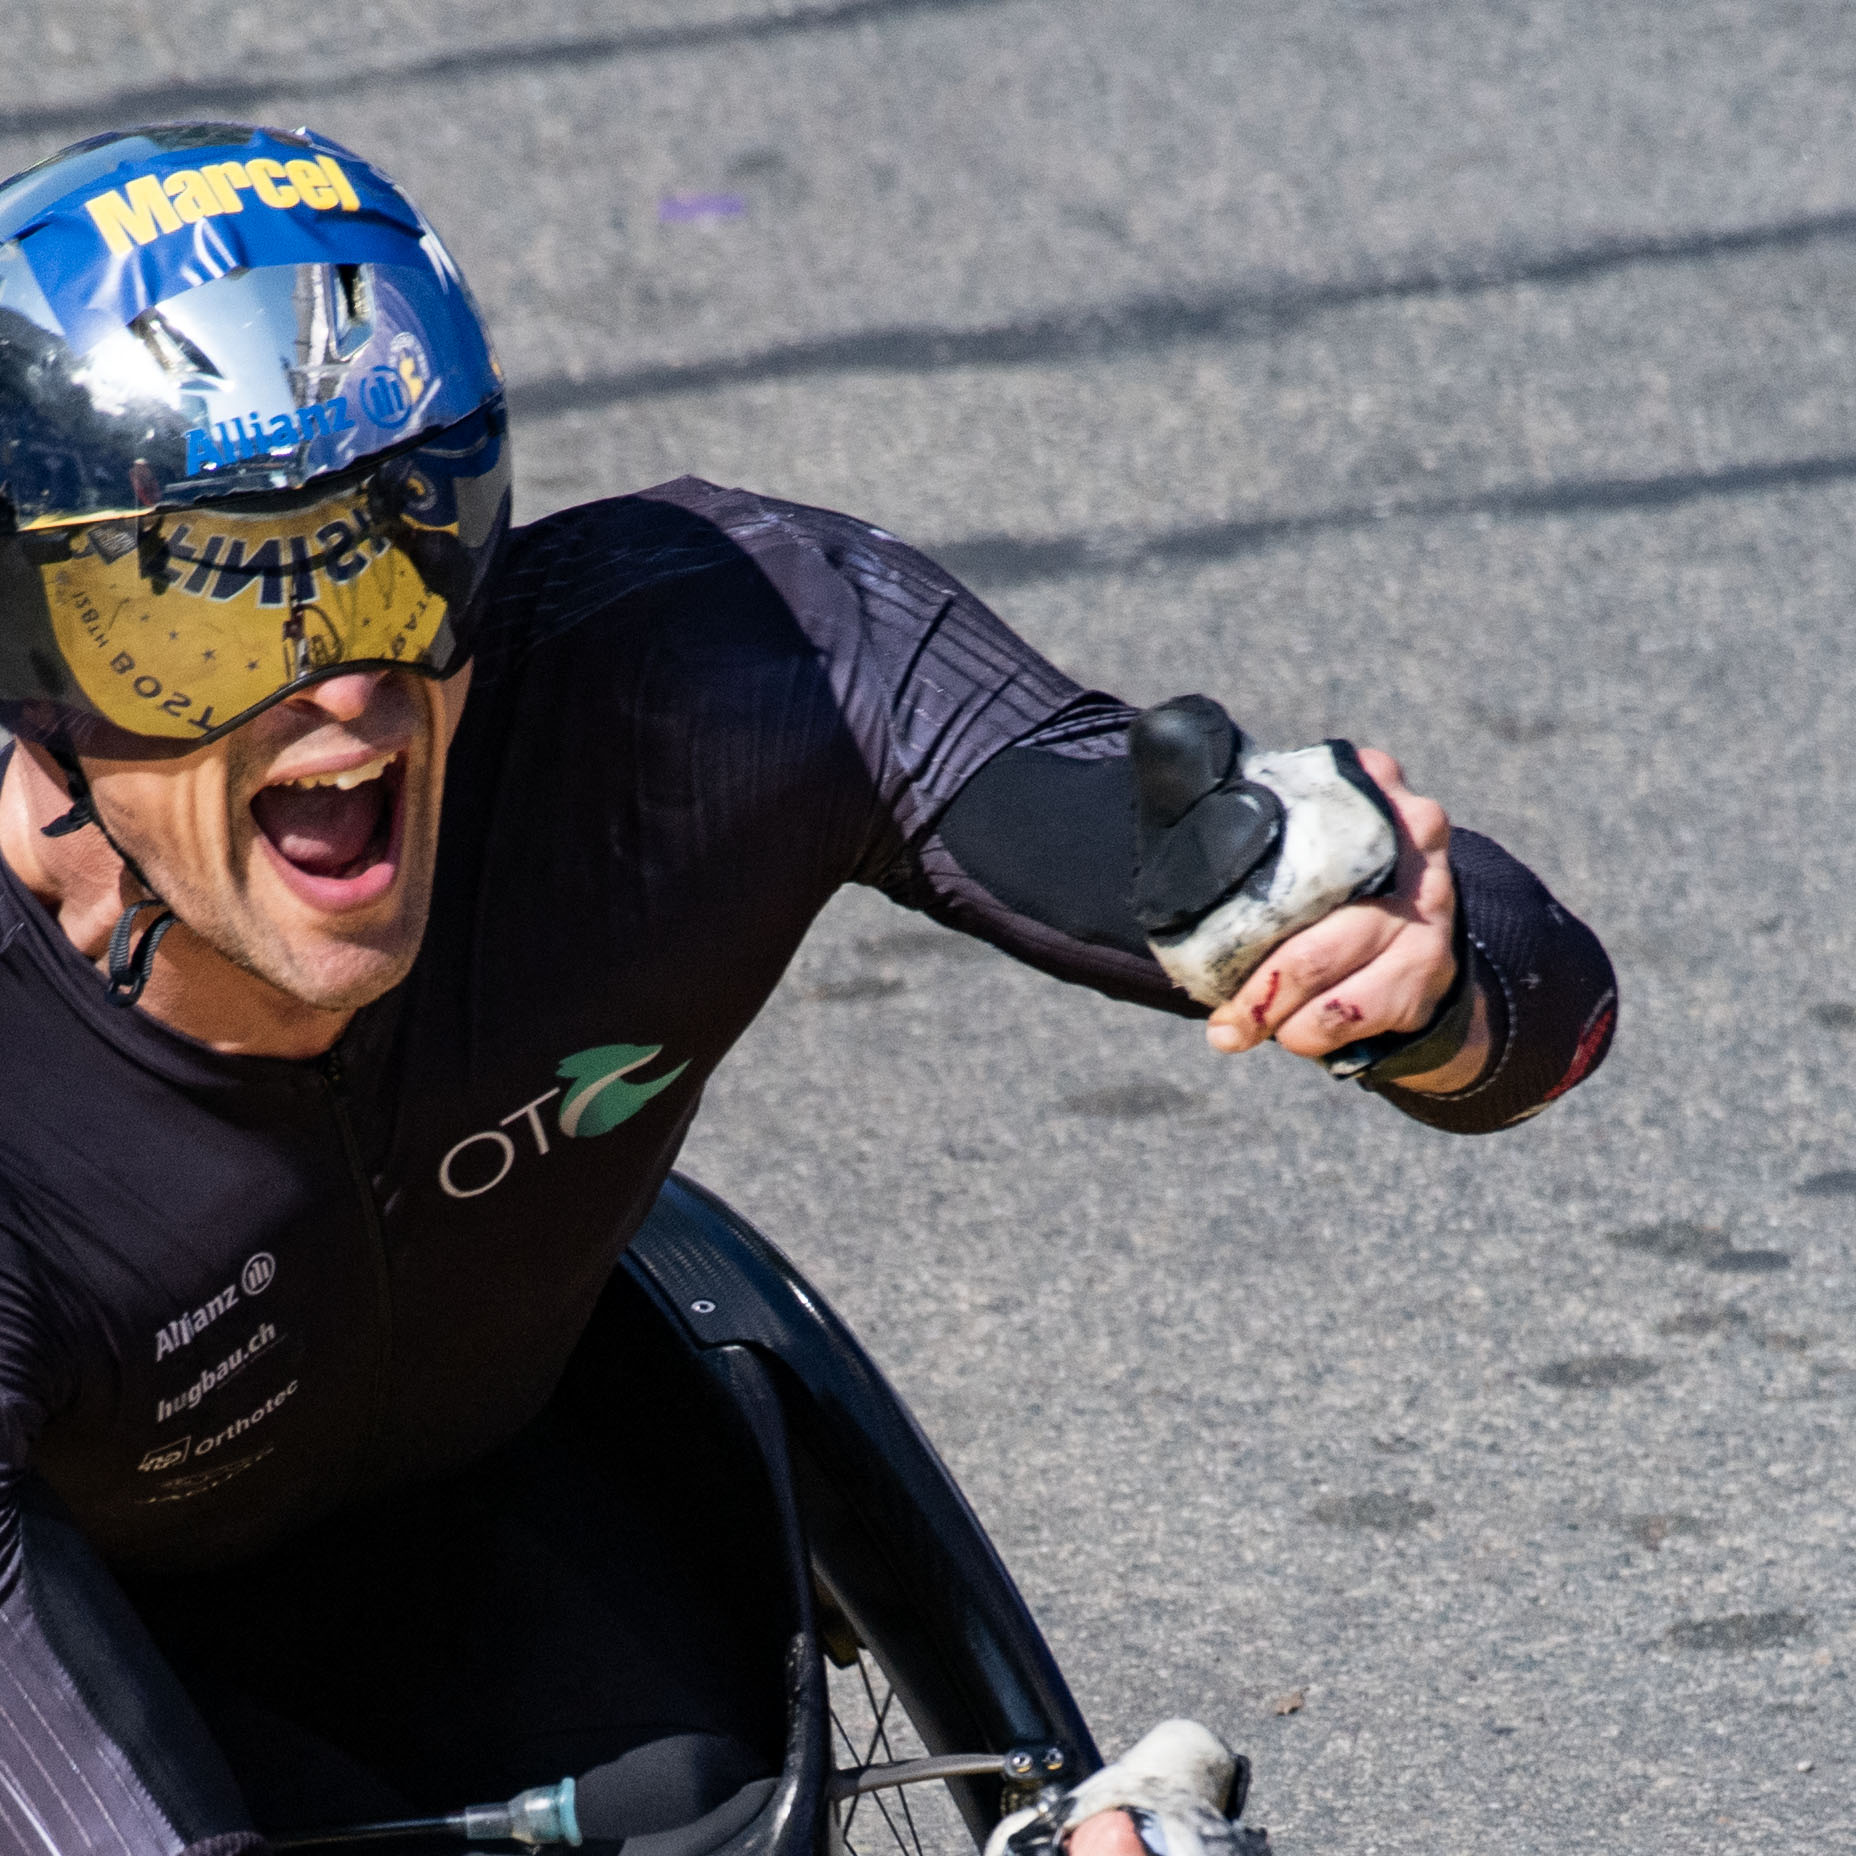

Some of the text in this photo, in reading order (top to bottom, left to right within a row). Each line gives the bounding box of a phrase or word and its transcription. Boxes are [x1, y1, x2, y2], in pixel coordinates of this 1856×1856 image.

[86, 155, 361, 257] Marcel
[185, 396, 355, 477] Allianz
[154, 1284, 240, 1363] Allianz
[156, 1322, 277, 1424] hugbau.ch
[194, 1379, 299, 1456] Orthotec
